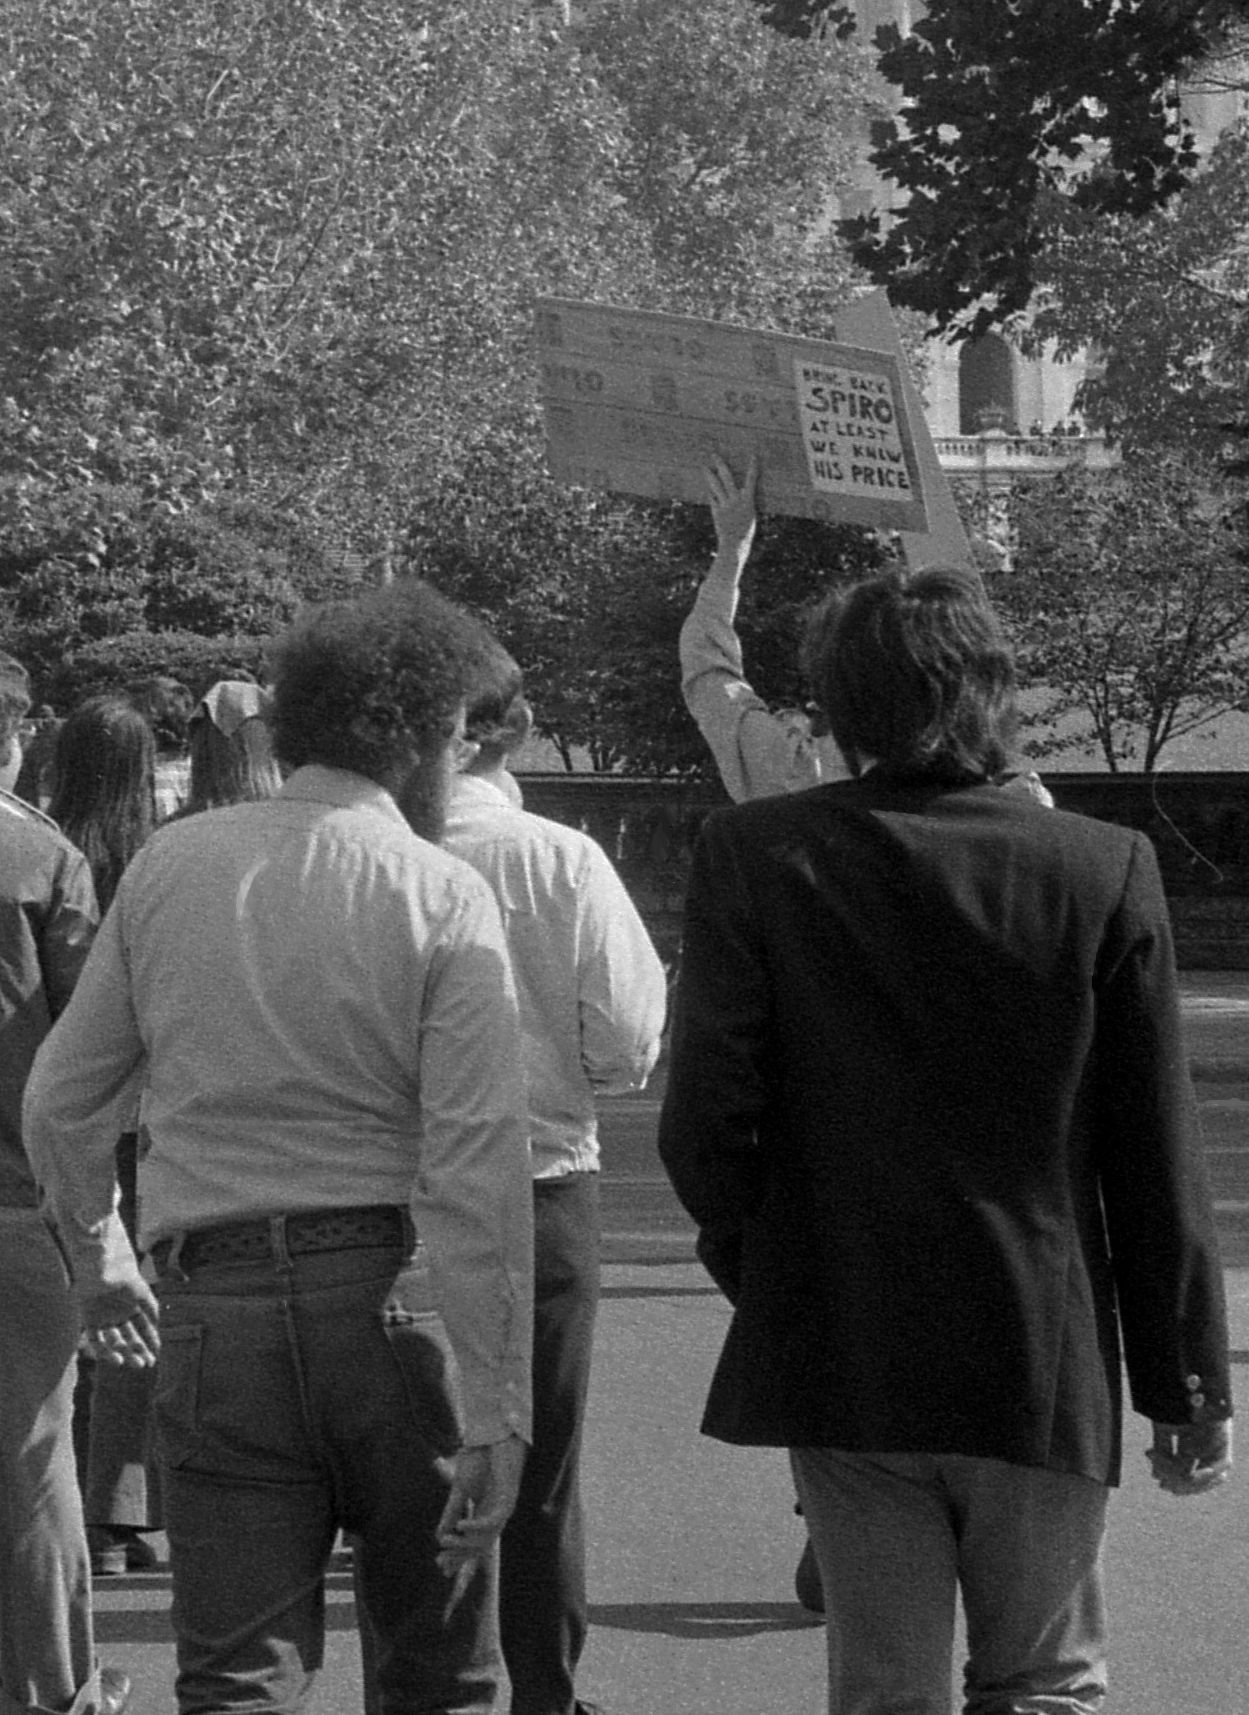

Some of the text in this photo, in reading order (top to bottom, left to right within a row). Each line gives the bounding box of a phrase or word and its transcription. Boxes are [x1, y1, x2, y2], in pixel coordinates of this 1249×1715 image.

[805, 387, 893, 424] SPIRO
[810, 419, 888, 441] AT LEAST
[811, 440, 839, 456] WE
[814, 461, 909, 490] HIS PRICE
